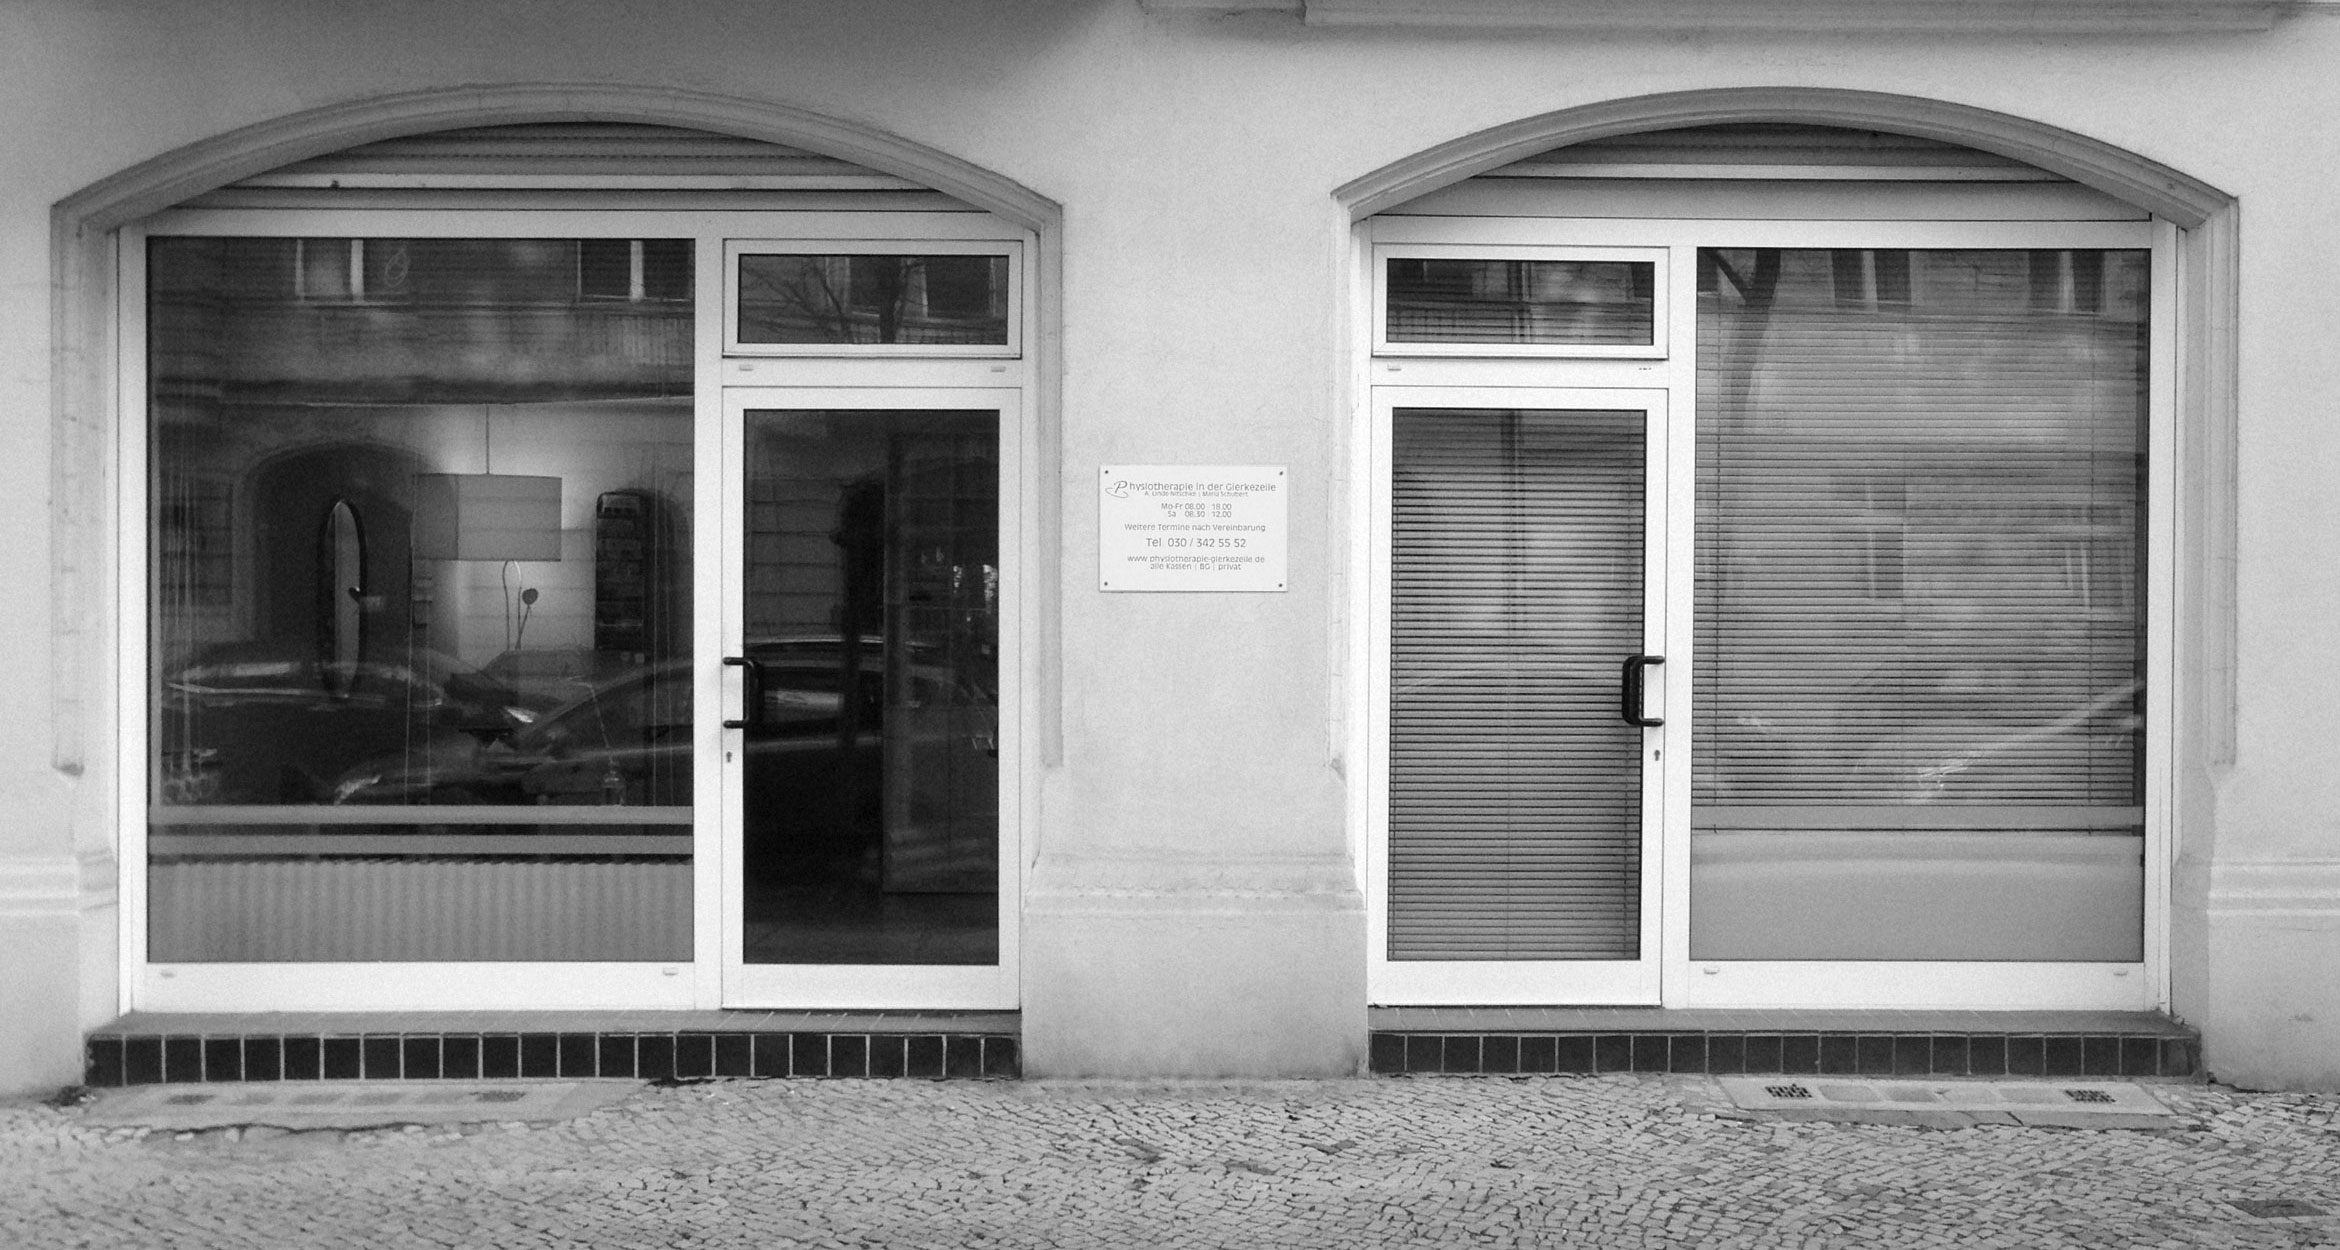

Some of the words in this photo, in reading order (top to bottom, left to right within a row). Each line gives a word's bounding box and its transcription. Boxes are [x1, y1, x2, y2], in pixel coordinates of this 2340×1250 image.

[1196, 482, 1205, 491] in
[1207, 483, 1224, 491] der
[1225, 483, 1277, 492] Gierkezeile
[1124, 523, 1156, 531] Weitere
[1157, 523, 1189, 531] Termine
[1191, 523, 1211, 531] nach
[1212, 524, 1266, 532] Vereinbarung
[1167, 538, 1187, 547] 030
[1196, 538, 1215, 548] 342
[1218, 538, 1231, 548] 55
[1233, 538, 1247, 548] 52
[1218, 563, 1242, 571] privat
